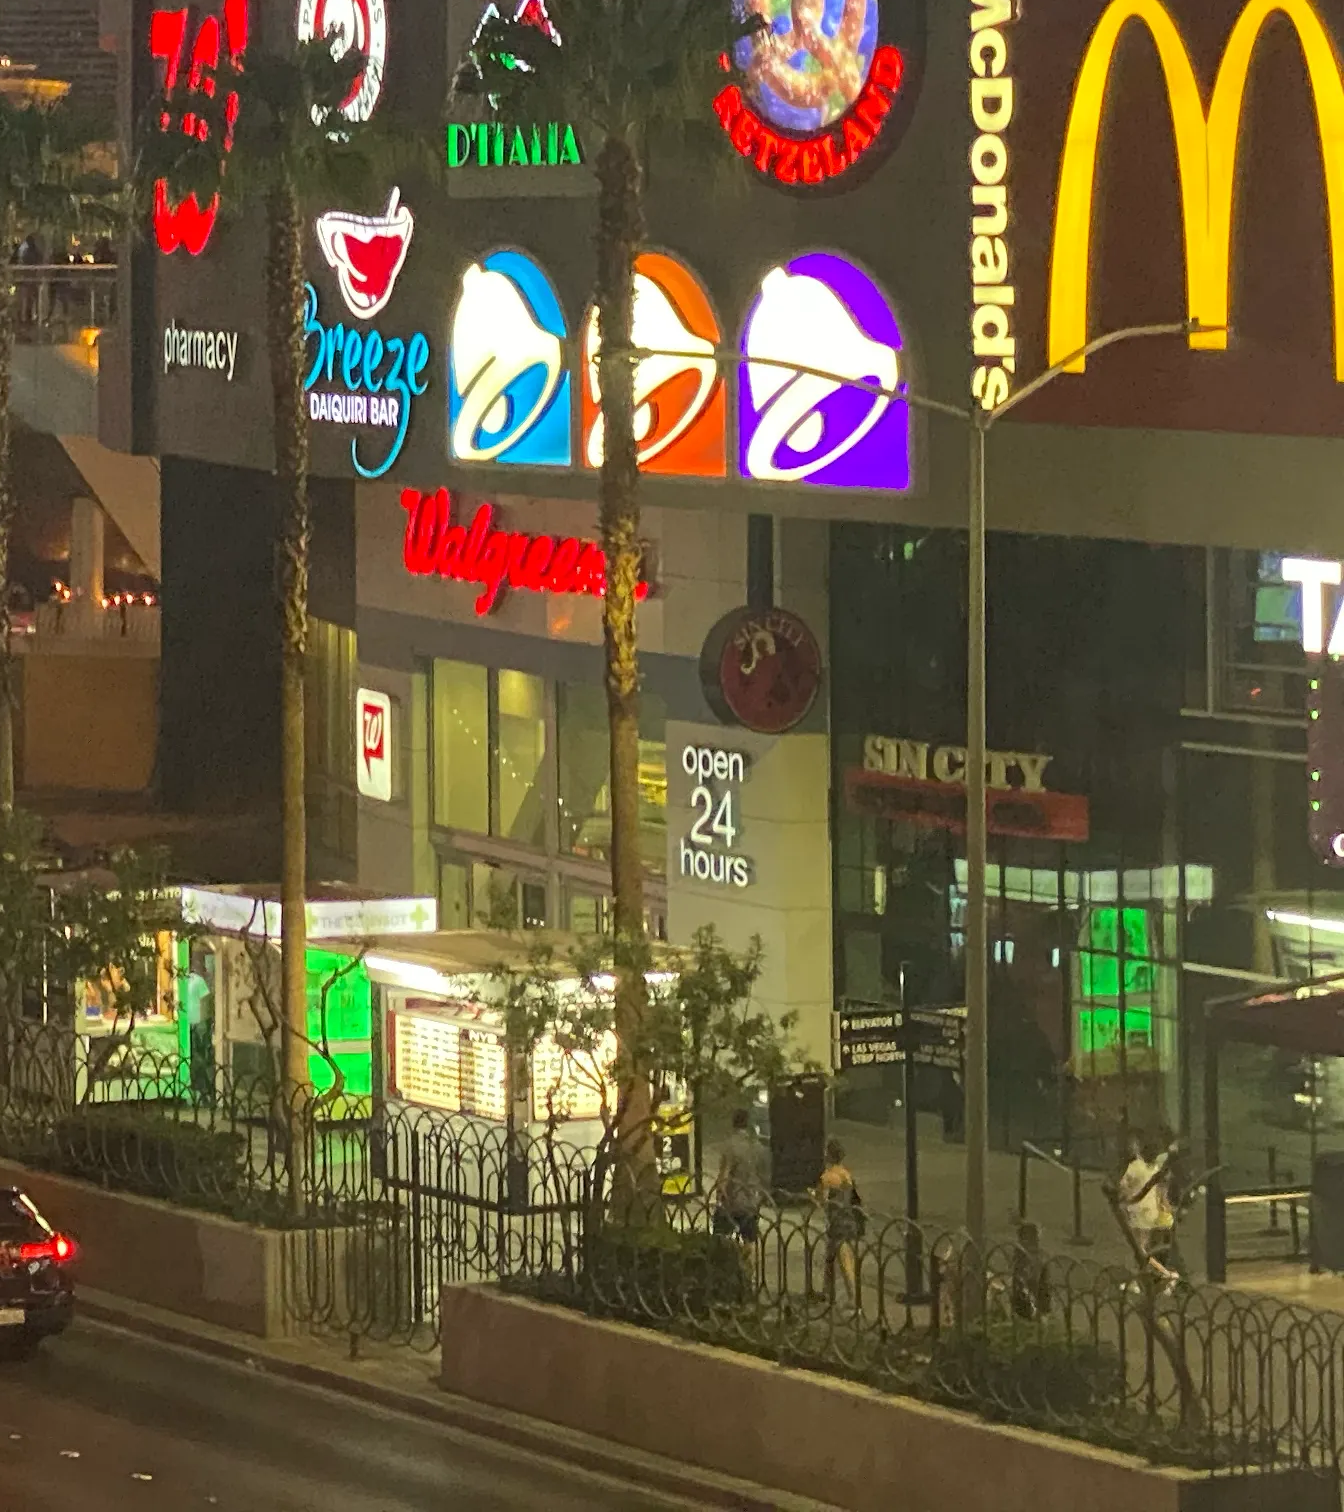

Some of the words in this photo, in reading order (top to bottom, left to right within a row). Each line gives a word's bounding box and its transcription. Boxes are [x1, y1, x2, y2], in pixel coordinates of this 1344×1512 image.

[712, 44, 905, 185] RETZELAND
[163, 317, 238, 382] pharmacy
[303, 281, 431, 479] Breeze
[309, 391, 367, 424] DAIQUIRI
[370, 395, 399, 427] BAR
[400, 486, 650, 617] Walgreen
[682, 744, 745, 786] open
[863, 734, 928, 781] SIN
[933, 744, 1054, 794] CTY
[690, 786, 737, 849] 24
[680, 837, 750, 888] hours
